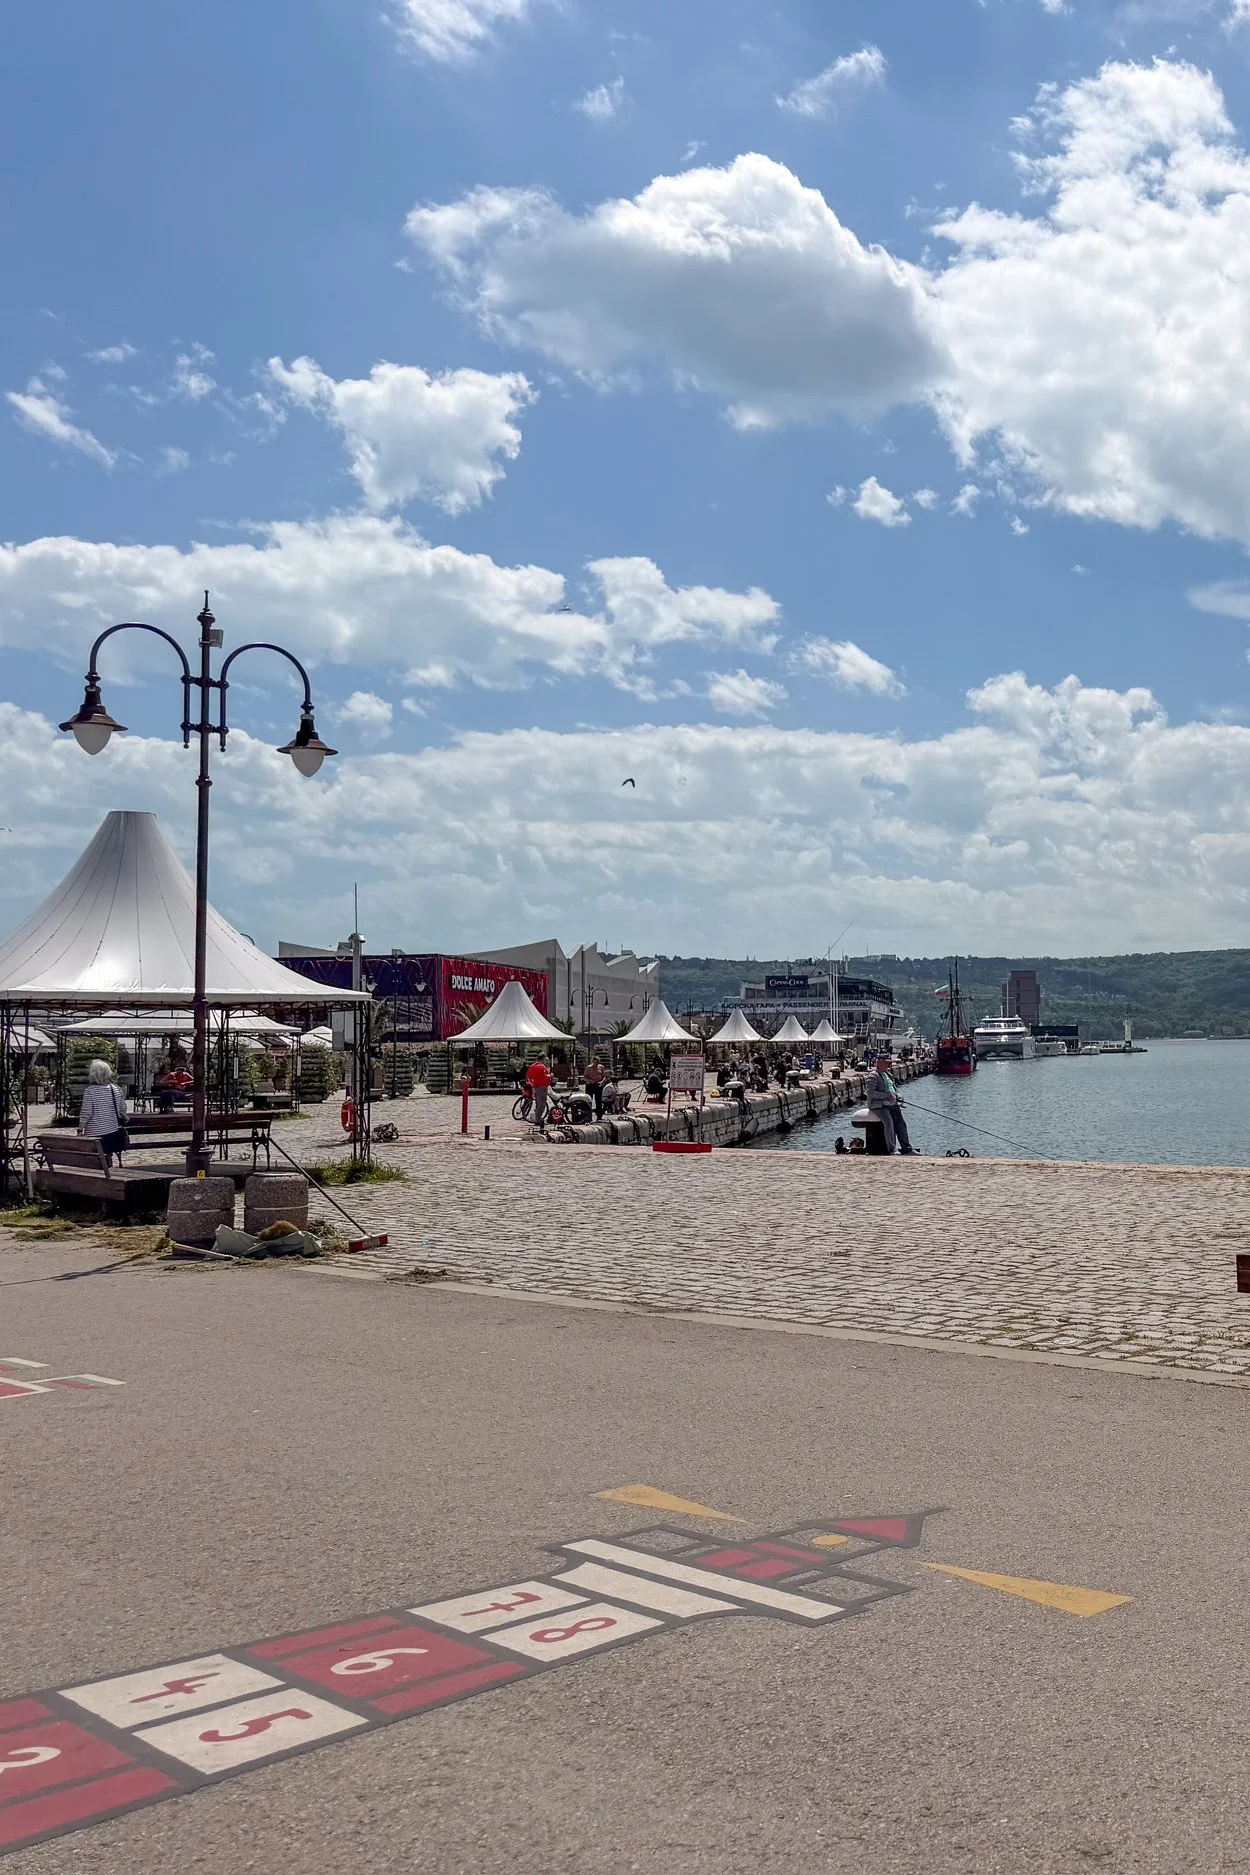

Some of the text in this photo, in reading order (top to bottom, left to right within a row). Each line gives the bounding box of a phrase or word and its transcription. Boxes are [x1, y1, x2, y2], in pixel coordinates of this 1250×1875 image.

[452, 975, 473, 990] DOLCE
[460, 1592, 543, 1617] 7
[528, 1617, 618, 1643] 8
[329, 1648, 429, 1675] 6
[129, 1672, 221, 1704] 4
[198, 1708, 313, 1743] 5
